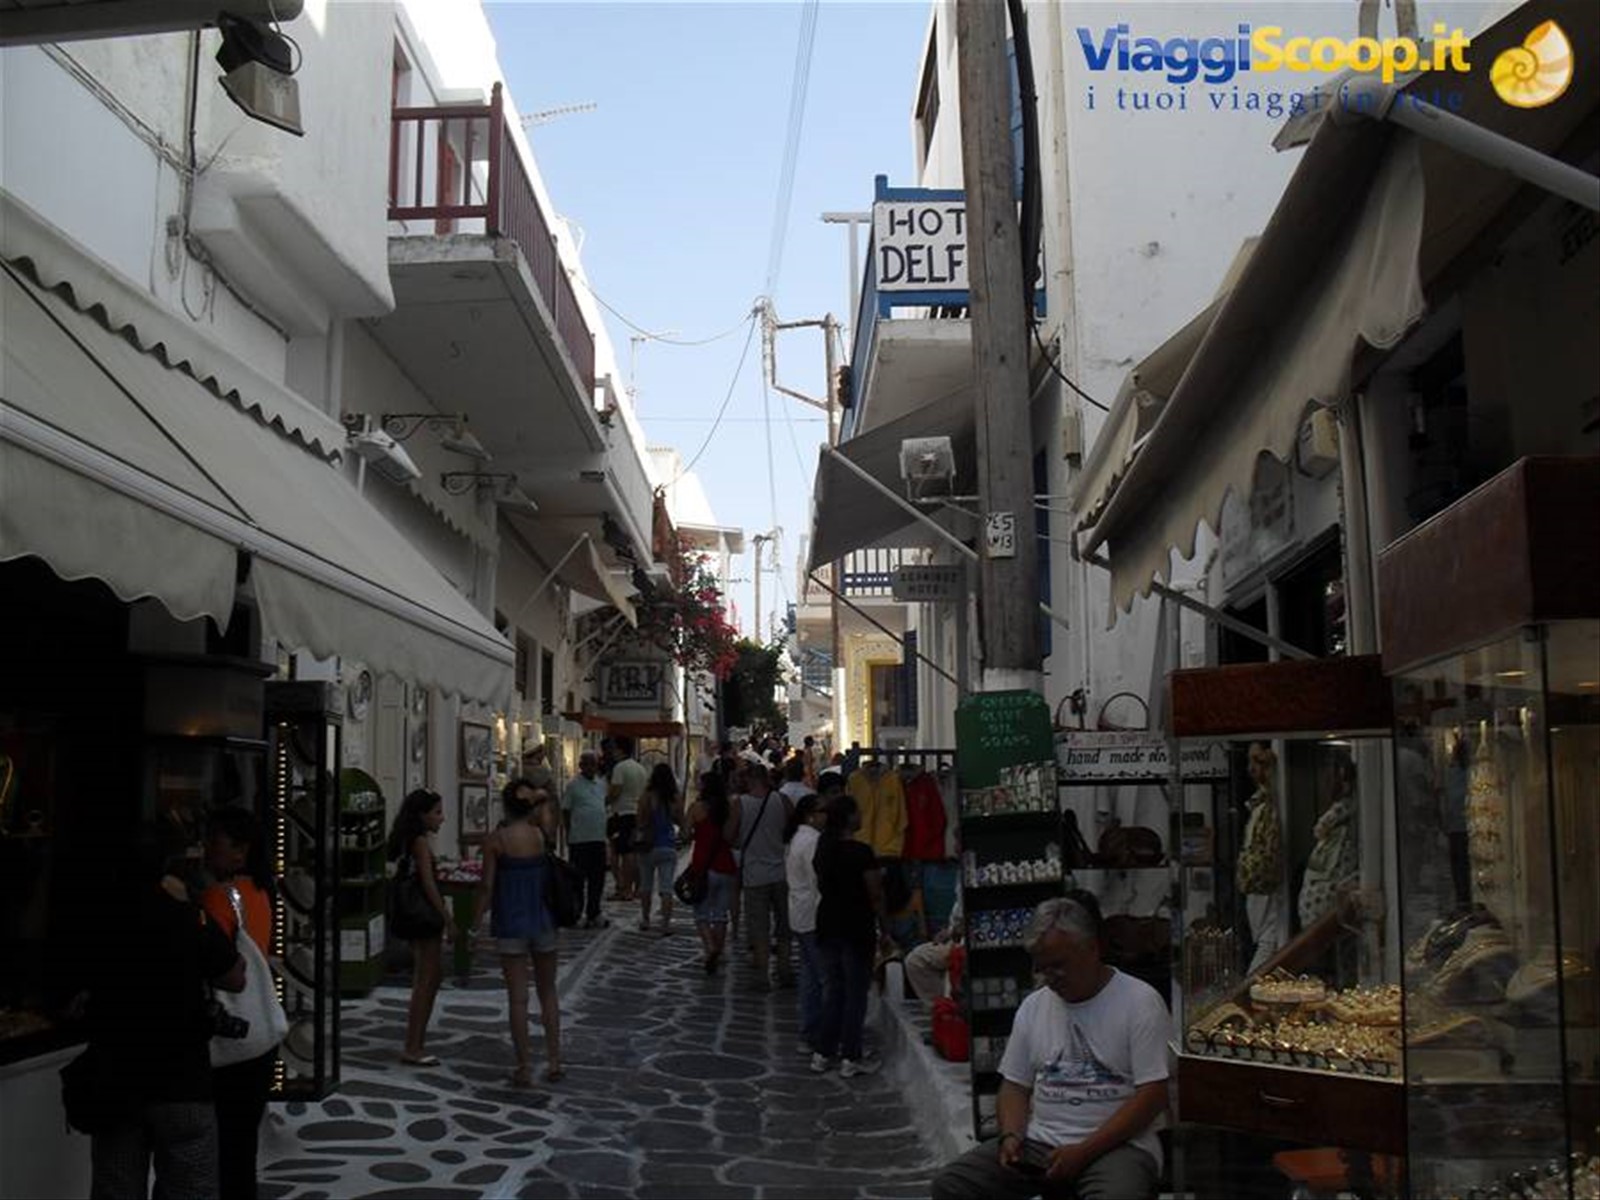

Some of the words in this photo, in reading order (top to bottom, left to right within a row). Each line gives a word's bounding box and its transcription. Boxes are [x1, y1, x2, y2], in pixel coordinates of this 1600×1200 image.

[889, 207, 966, 236] HOT
[1067, 747, 1101, 765] hand
[1109, 746, 1146, 764] made
